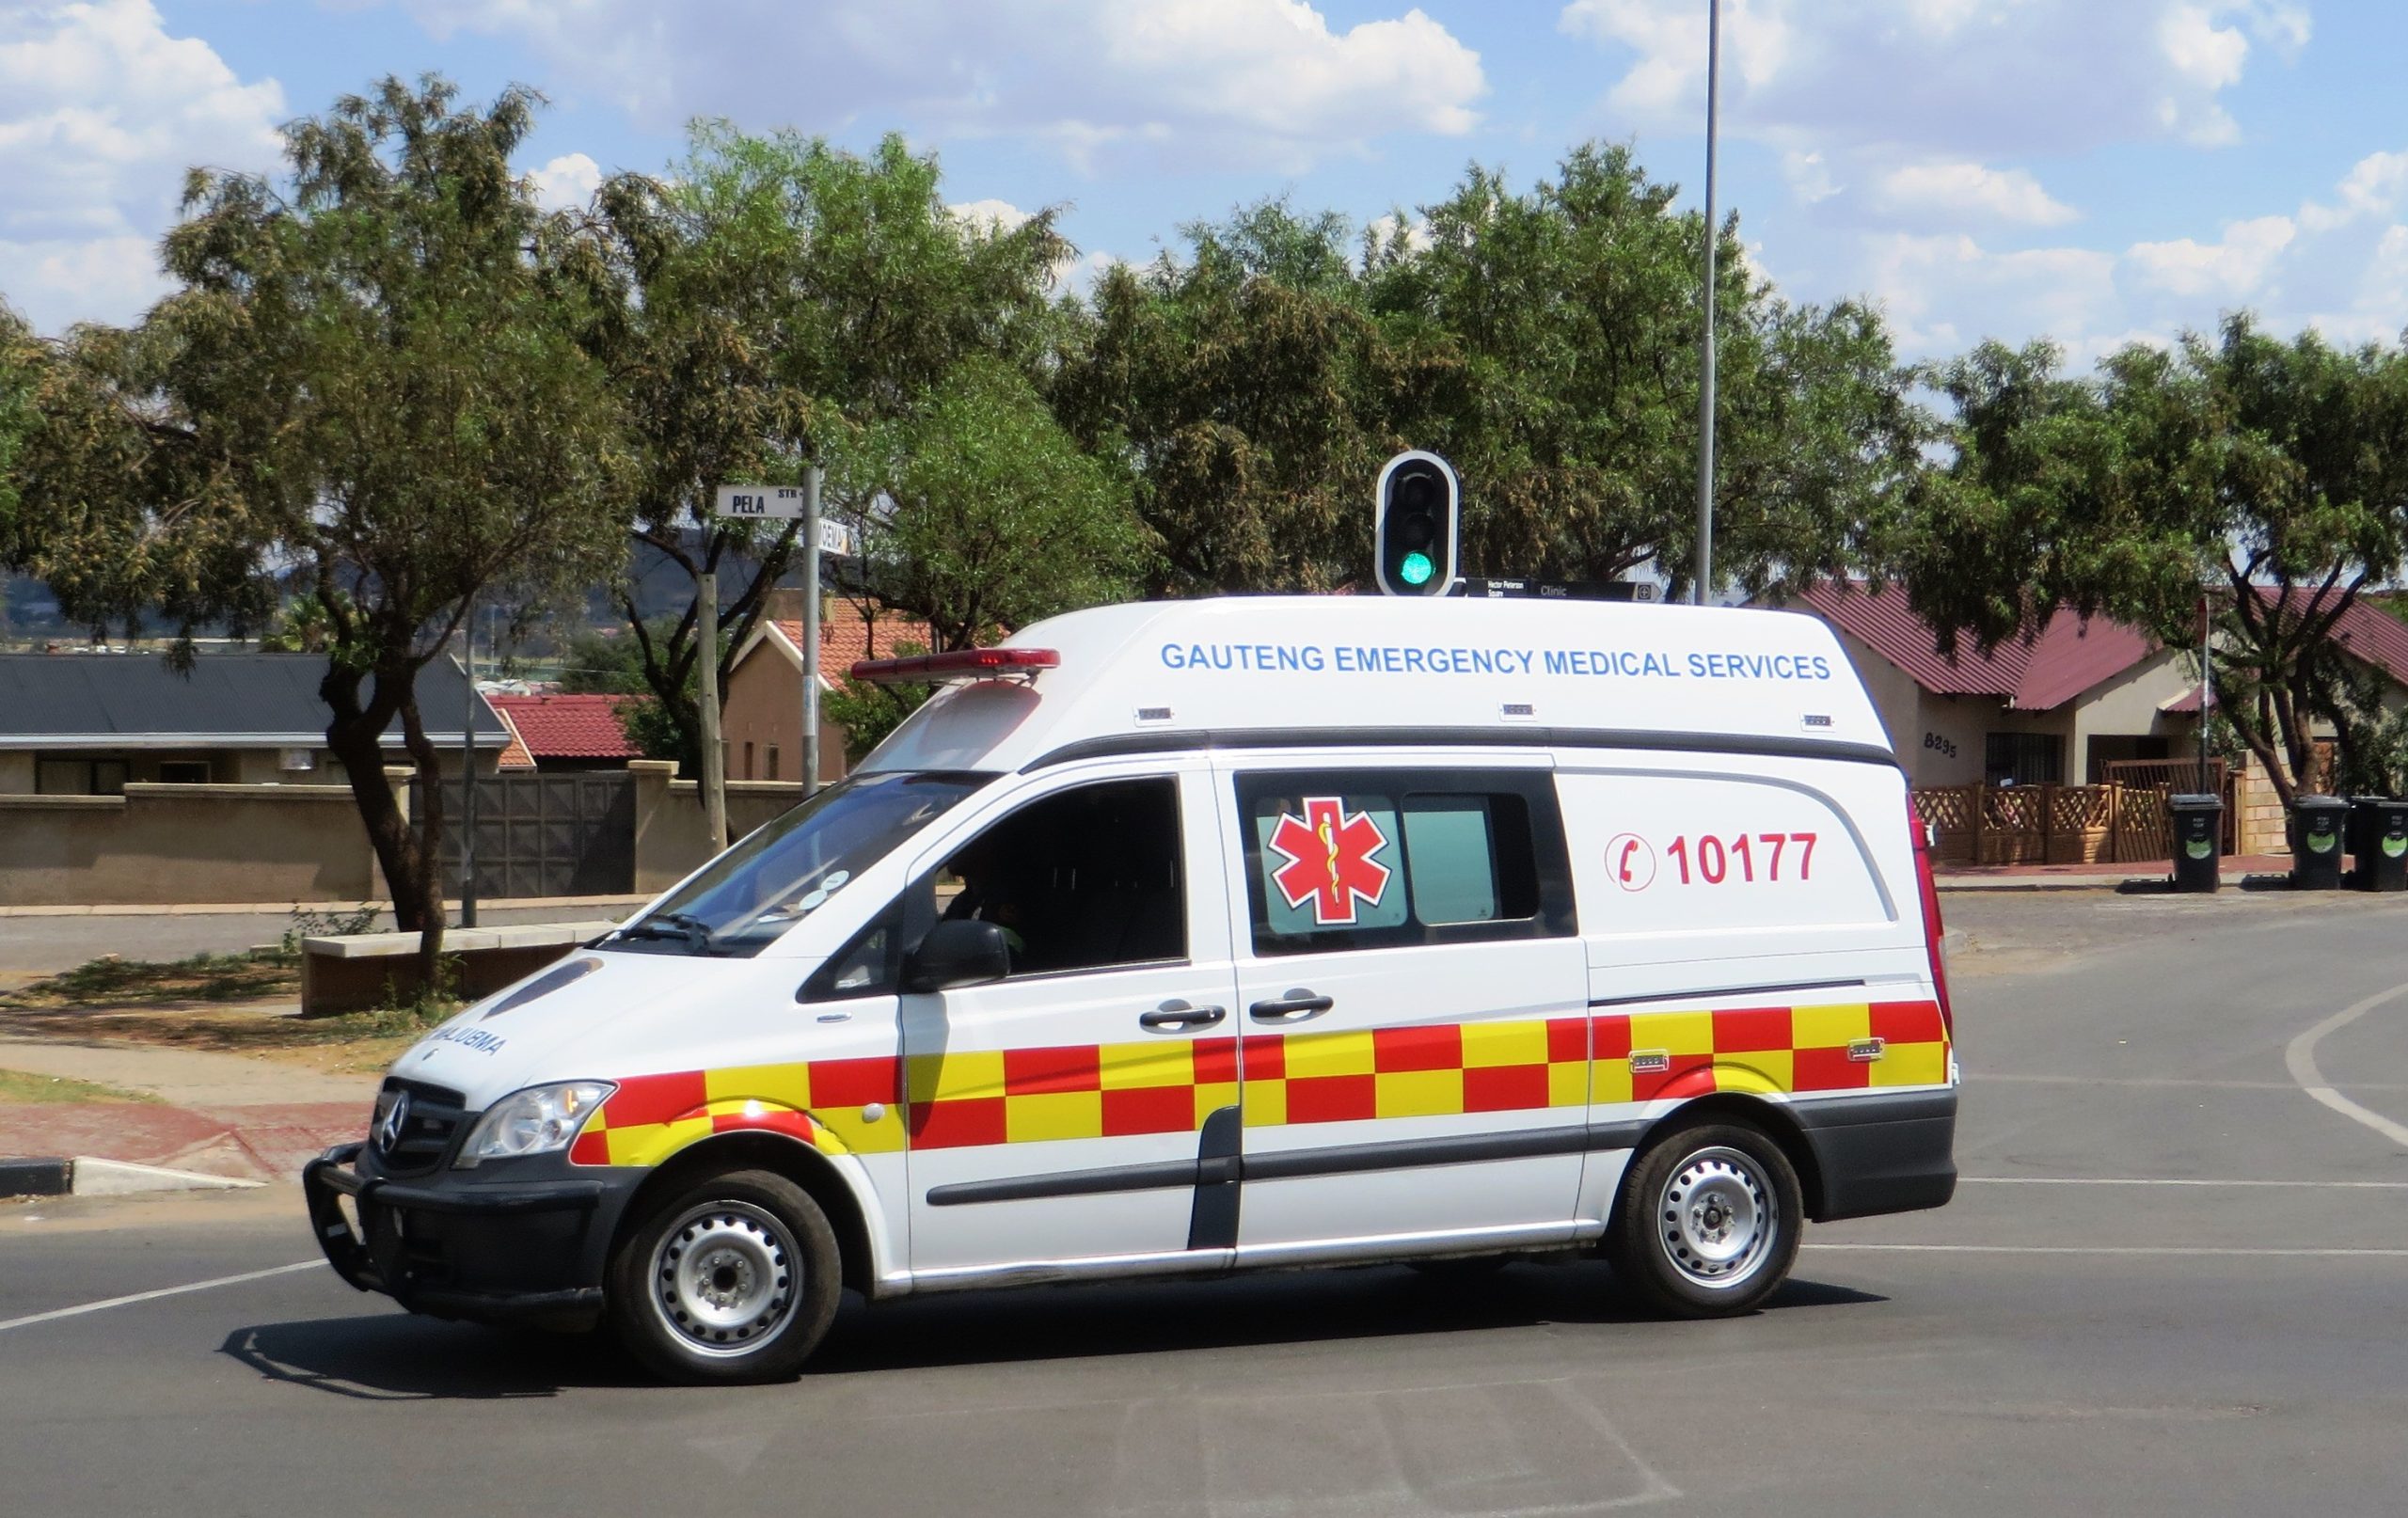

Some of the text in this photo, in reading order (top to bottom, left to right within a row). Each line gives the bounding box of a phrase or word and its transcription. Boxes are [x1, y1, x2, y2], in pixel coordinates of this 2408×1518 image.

[733, 489, 798, 514] PELA STR
[1541, 585, 1567, 596] Clinic
[1161, 643, 1830, 680] GAUTENG EMERGENCY MEDICAL SERVICES
[1669, 833, 1816, 883] 10177
